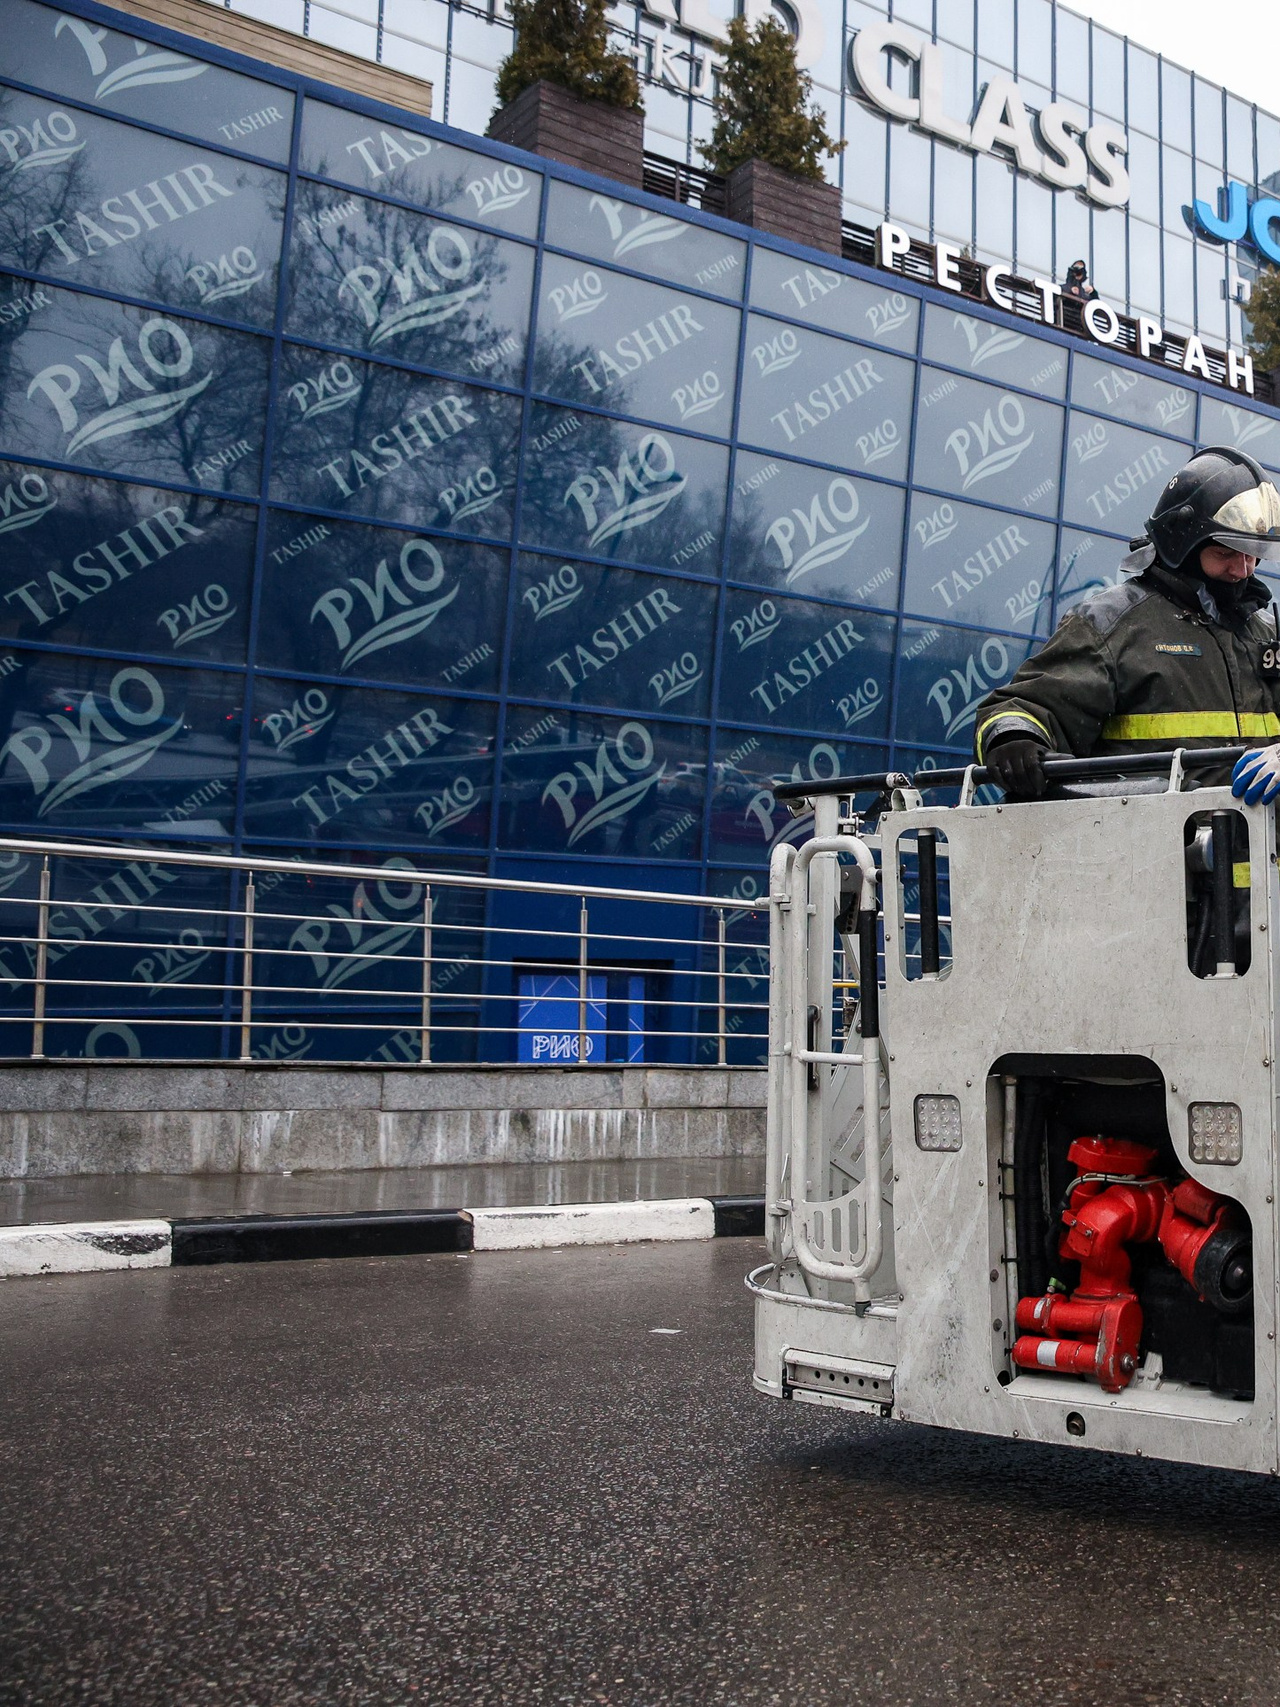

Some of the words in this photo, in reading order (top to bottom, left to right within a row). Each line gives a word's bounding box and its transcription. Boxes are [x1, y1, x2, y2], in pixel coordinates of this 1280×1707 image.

[218, 106, 284, 142] TASHIR
[852, 21, 1131, 209] CLASS
[465, 163, 524, 209] РИО
[32, 162, 234, 265] TASHIR
[186, 245, 258, 297] РИО
[338, 226, 472, 328] РИО
[548, 271, 602, 315] РИО
[866, 291, 907, 330] РИО
[880, 222, 1254, 394] РЕСТОРАН
[571, 304, 705, 393] TASHIR
[751, 330, 797, 371] РИО
[27, 318, 194, 433] РИО
[288, 362, 354, 413] РИО
[671, 370, 720, 415] РИО
[770, 358, 884, 442] TASHIR
[1156, 388, 1188, 423] РИО
[317, 394, 479, 499] TASHIR
[531, 415, 582, 452] TASHIR
[855, 419, 897, 459] РИО
[944, 394, 1025, 478] РИО
[1072, 422, 1106, 458] РИО
[438, 466, 497, 516] РИО
[564, 433, 675, 531] РИО
[737, 462, 780, 496] TASHIR
[1086, 445, 1170, 519] TASHIR
[270, 523, 331, 566] TASHIR
[671, 530, 716, 566] TASHIR
[764, 477, 859, 568] РИО
[914, 503, 954, 543] РИО
[3, 506, 204, 626] TASHIR
[523, 565, 578, 614] РИО
[855, 566, 894, 600] TASHIR
[930, 524, 1030, 609] TASHIR
[157, 584, 229, 640] РИО
[310, 538, 446, 650] РИО
[1004, 579, 1041, 618] РИО
[546, 587, 683, 690] TASHIR
[730, 600, 776, 645] РИО
[439, 643, 495, 684] TASHIR
[648, 652, 698, 700] РИО
[750, 619, 865, 714] TASHIR
[927, 637, 1009, 726] РИО
[262, 689, 328, 743] РИО
[837, 678, 879, 722] РИО
[0, 667, 165, 795] РИО
[508, 714, 558, 754] TASHIR
[293, 707, 455, 827] TASHIR
[542, 722, 655, 828] РИО
[415, 776, 475, 829] РИО
[650, 813, 696, 852] TASHIR
[288, 857, 424, 978] РИО
[533, 1035, 594, 1059] РИО
